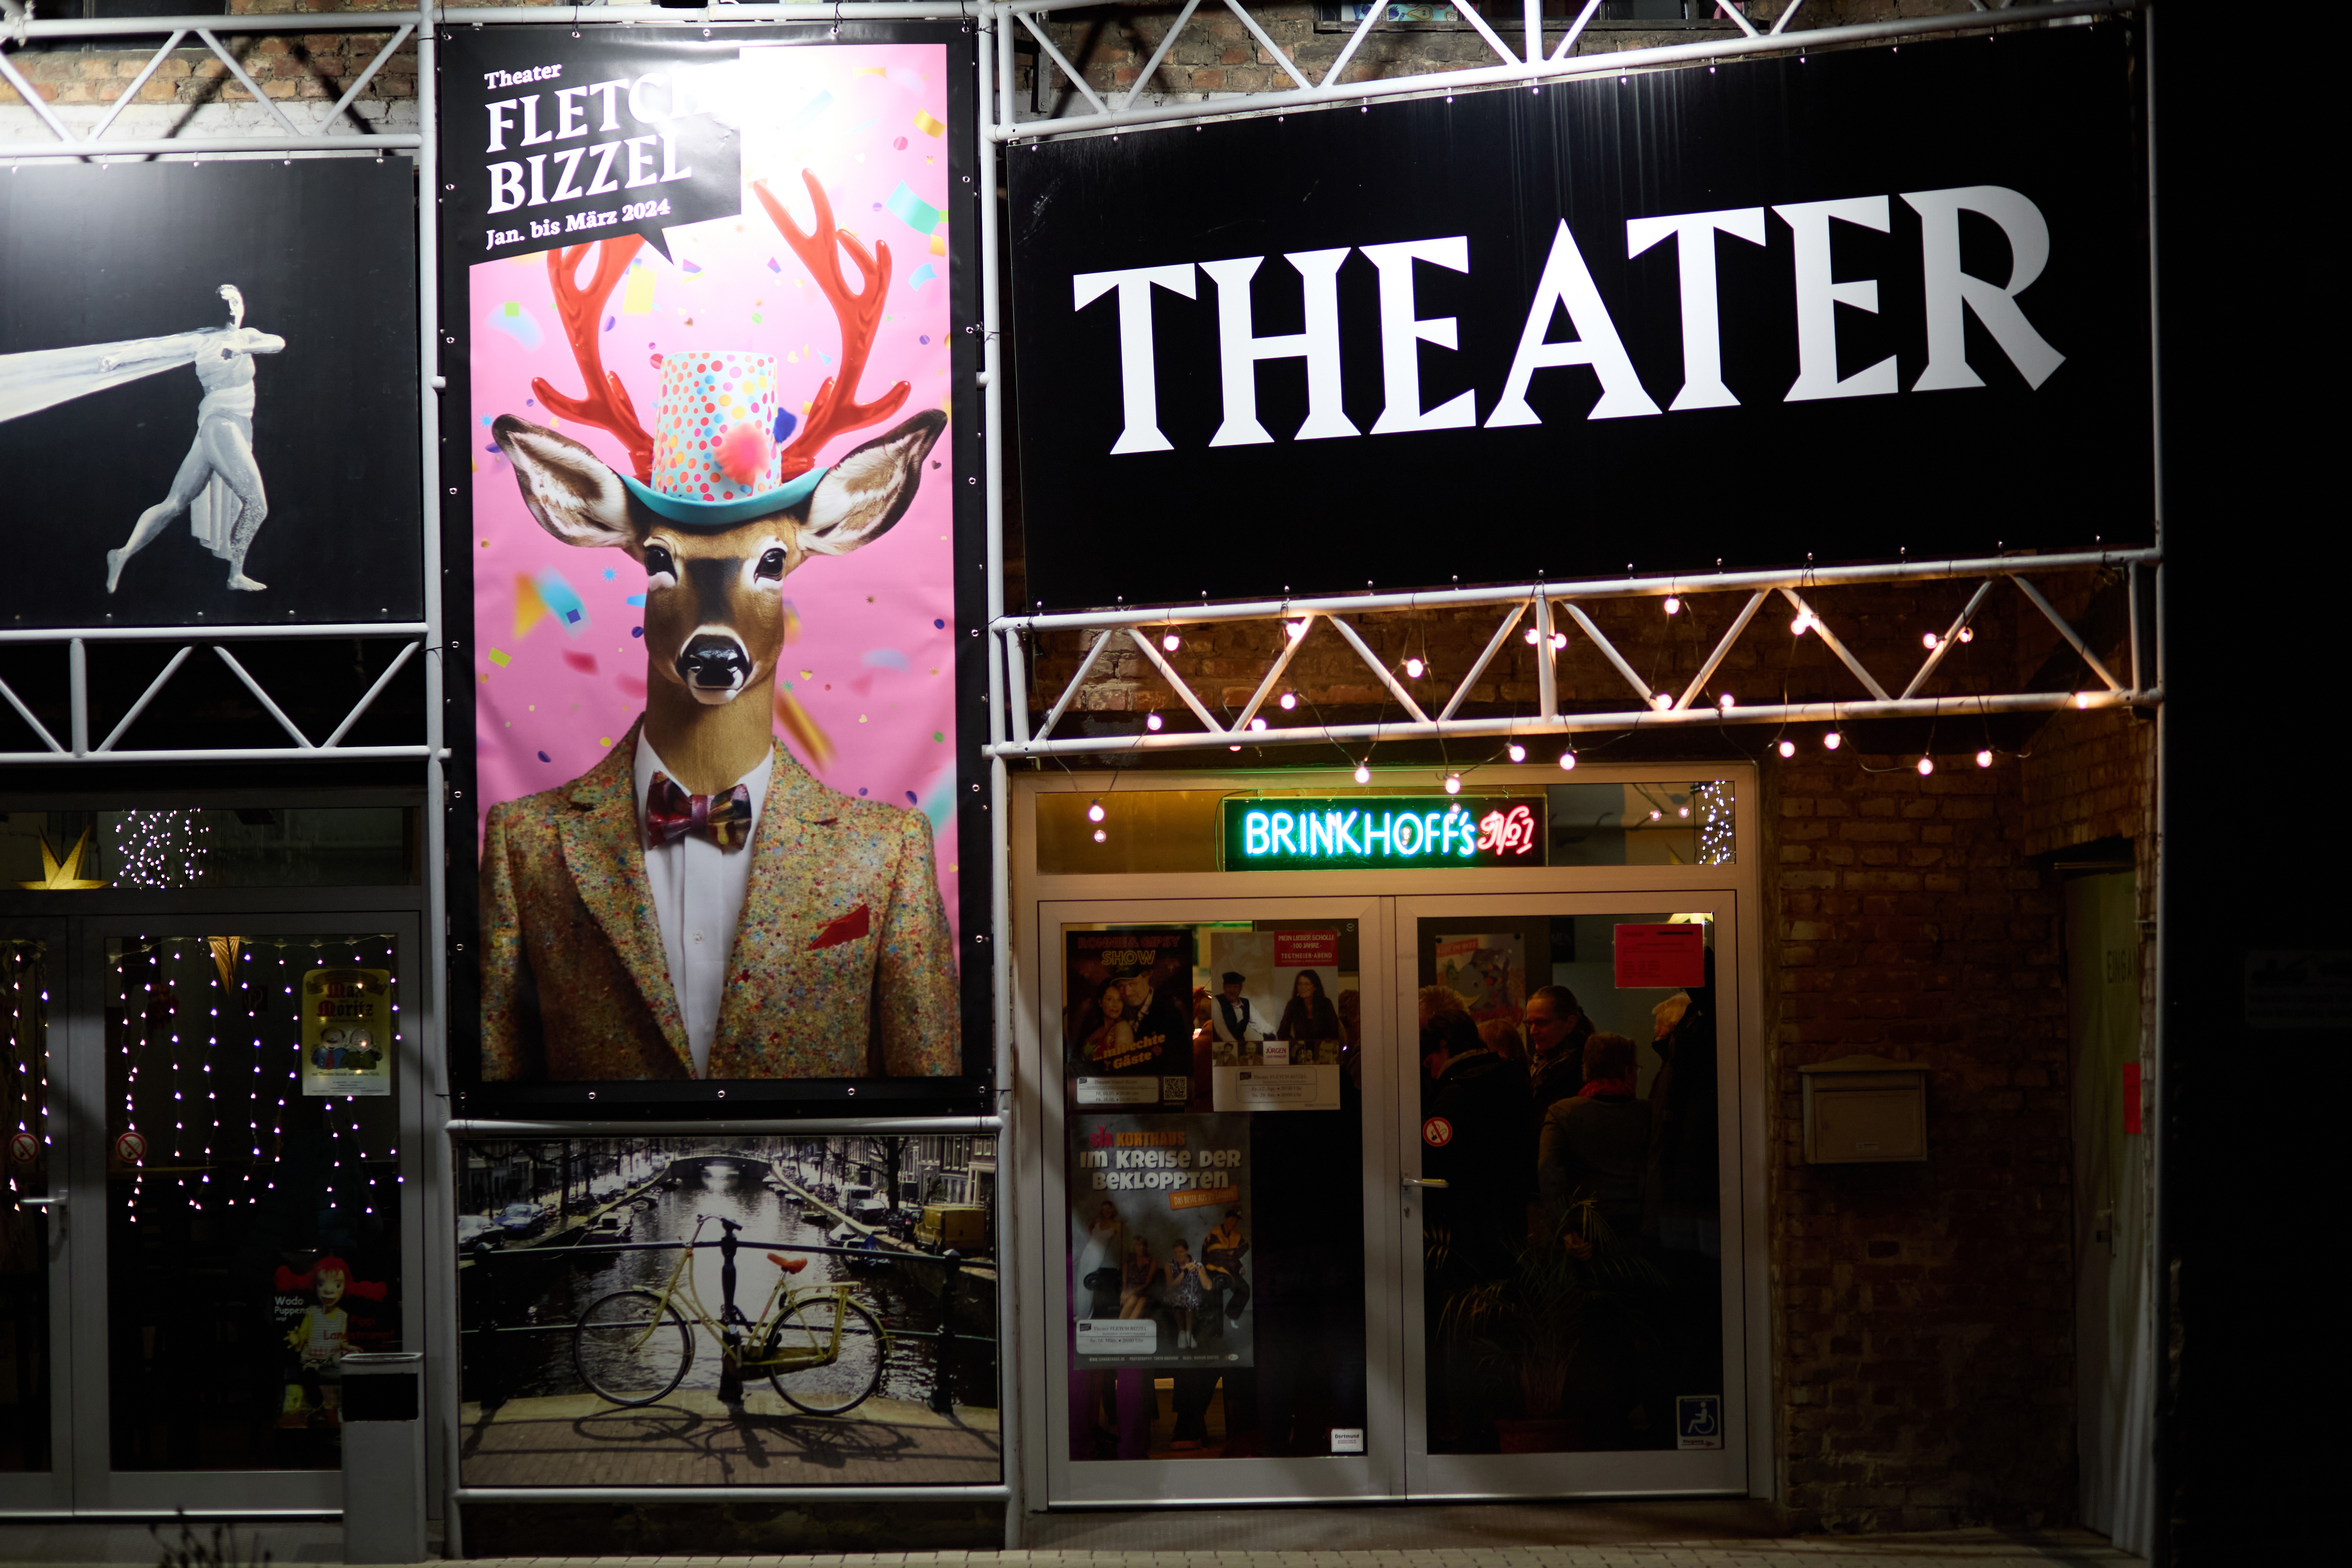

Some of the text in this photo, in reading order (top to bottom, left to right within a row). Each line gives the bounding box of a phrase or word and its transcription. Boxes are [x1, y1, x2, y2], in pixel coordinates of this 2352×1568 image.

[484, 63, 562, 89] Theater
[486, 129, 691, 214] BIZZEL
[486, 198, 670, 250] Jan. bis März 2024
[1074, 185, 2066, 455] THEATER
[1101, 950, 1156, 965] SHOW
[326, 982, 364, 998] Max
[316, 1000, 373, 1017] Moritz
[1129, 1034, 1166, 1051] echte
[1113, 1051, 1152, 1069] Gäste
[1116, 1131, 1186, 1147] KORTHAUS
[274, 1296, 304, 1305] Wodo
